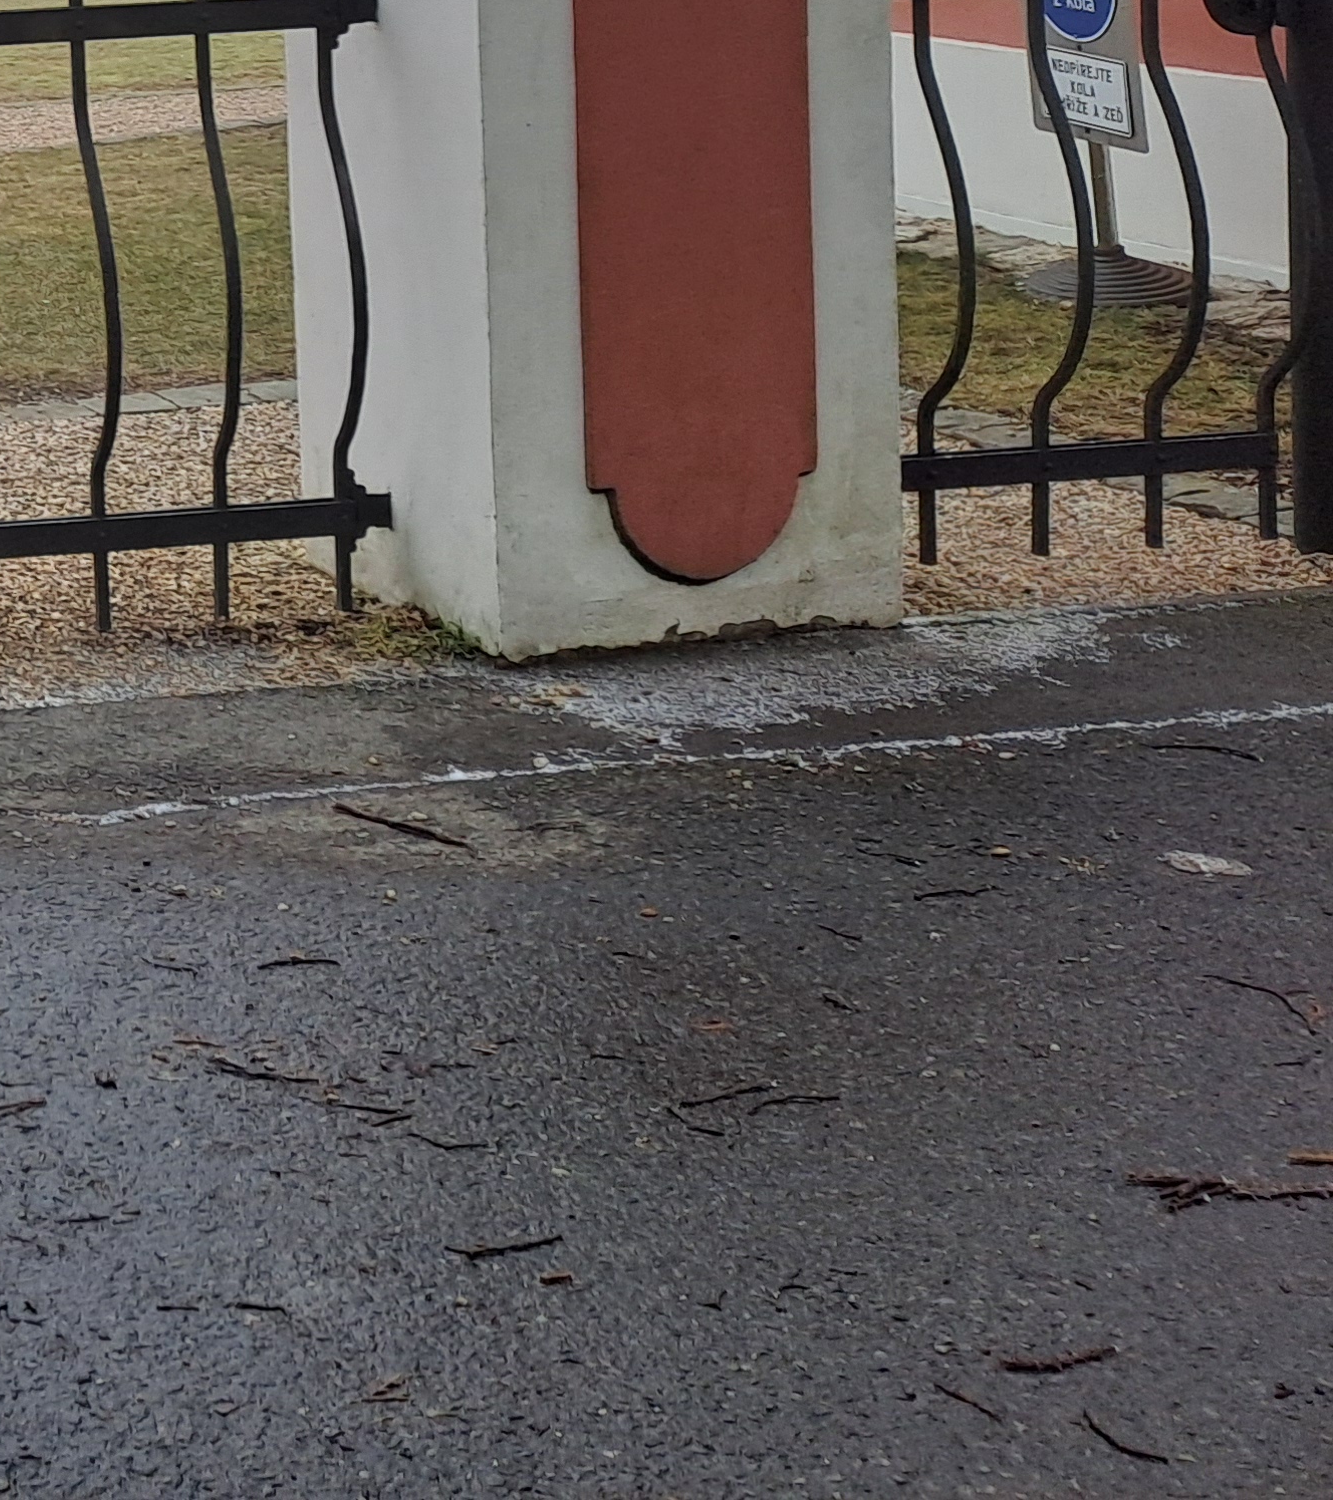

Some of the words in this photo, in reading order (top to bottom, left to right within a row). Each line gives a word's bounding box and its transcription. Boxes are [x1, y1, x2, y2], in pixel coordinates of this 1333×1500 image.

[1070, 80, 1096, 97] KOLA
[1061, 94, 1089, 115] ŘÍŽE
[1093, 104, 1099, 117] A
